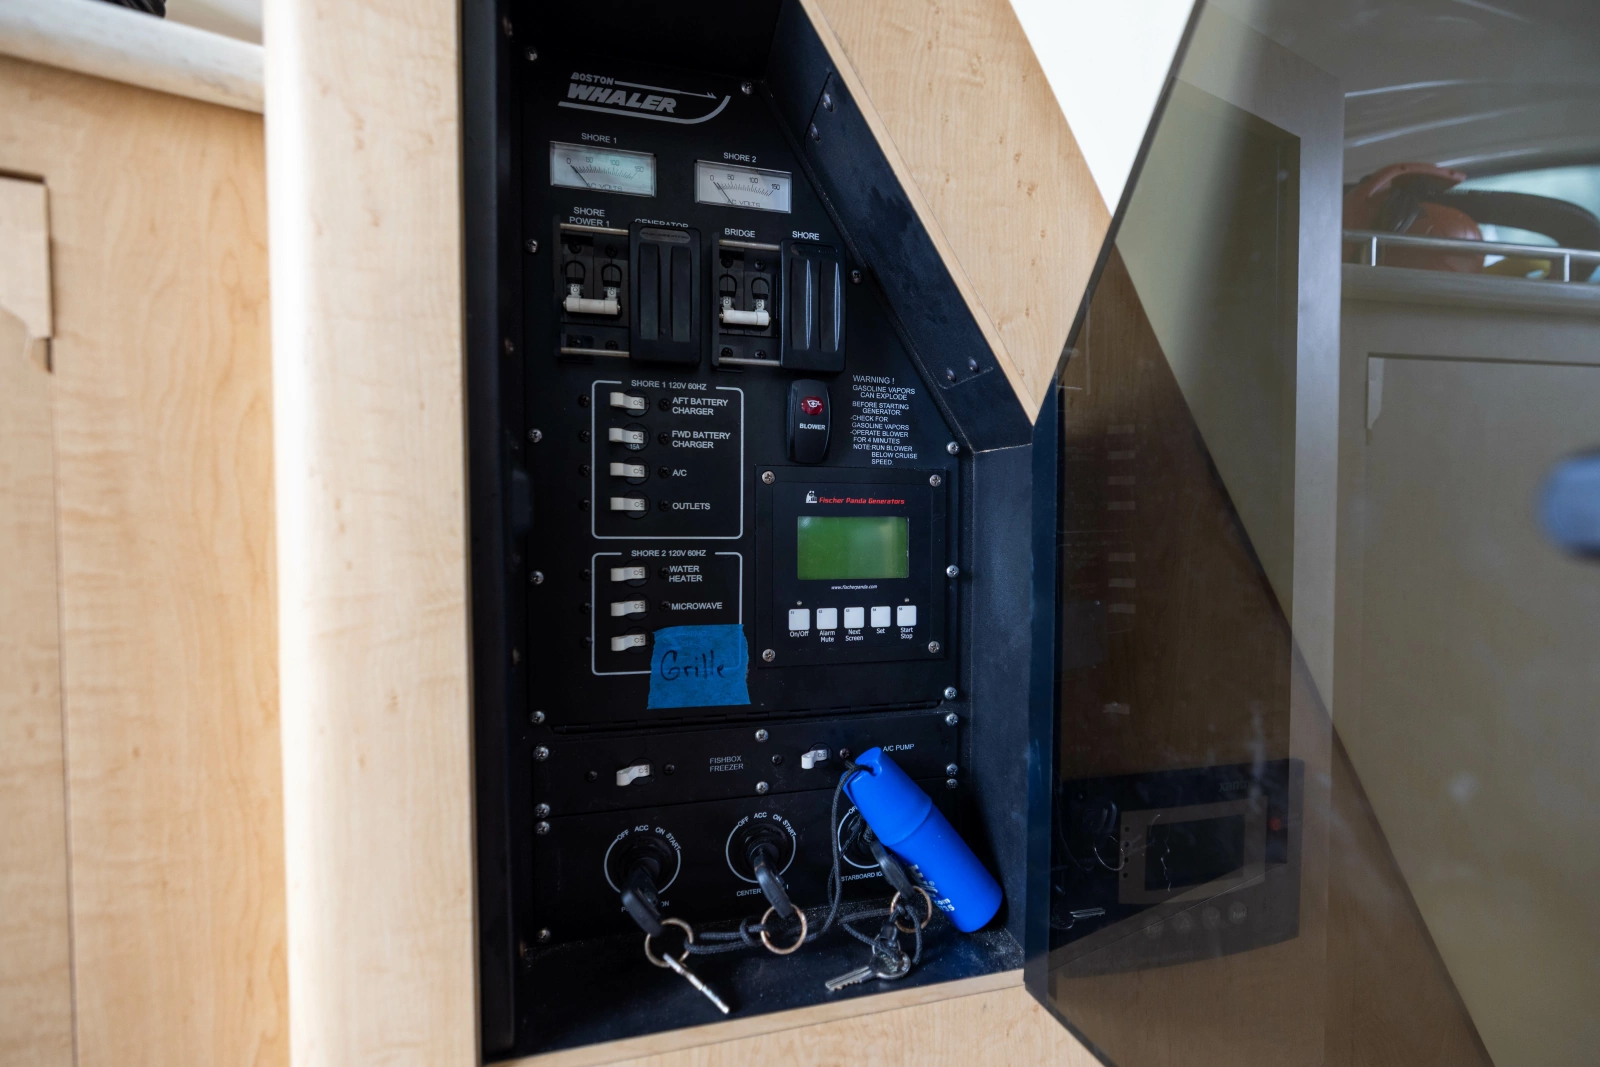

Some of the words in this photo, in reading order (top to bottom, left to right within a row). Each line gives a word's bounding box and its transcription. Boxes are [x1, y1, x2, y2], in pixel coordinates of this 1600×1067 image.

[570, 72, 614, 86] BOSTON
[567, 83, 677, 114] WHALER
[581, 133, 611, 143] SHORE
[723, 152, 750, 162] SHORE
[573, 206, 605, 217] SHORE
[569, 216, 603, 227] POWER
[606, 220, 610, 228] 1
[724, 228, 756, 238] BRIDGE
[792, 230, 820, 240] SHORE
[631, 380, 660, 388] SHORE
[853, 375, 890, 384] WARNING
[853, 385, 886, 393] GASOLINE
[888, 387, 916, 395] VAPORS
[691, 398, 728, 406] BATTERY
[879, 402, 909, 410] STARTING
[672, 407, 714, 415] CHARGER
[852, 422, 883, 430] GASOLINE
[693, 431, 731, 439] BATTERY
[850, 429, 881, 437] -OPERATE
[882, 430, 909, 438] BLOWER
[672, 440, 714, 449] CHARGER
[895, 452, 918, 460] CRUISE
[672, 469, 687, 477] A/C
[819, 496, 844, 504] Fischer
[868, 497, 905, 505] Generators
[672, 502, 710, 510] OUTLETS
[669, 565, 700, 573] WATER
[669, 575, 703, 583] HEATER
[671, 602, 723, 610] MICROWAVE
[789, 630, 809, 638] On/Off
[660, 650, 727, 681] Grille
[895, 743, 915, 751] PUMP
[710, 755, 742, 764] FISHBOX
[710, 763, 744, 772] FREEZER
[737, 816, 750, 827] OFF
[772, 814, 783, 822] ON
[782, 819, 797, 837] START
[616, 829, 630, 841] OFF
[655, 826, 666, 835] ON
[666, 832, 682, 851] START
[841, 872, 876, 882] STARBOARD
[736, 888, 762, 897] CENTER
